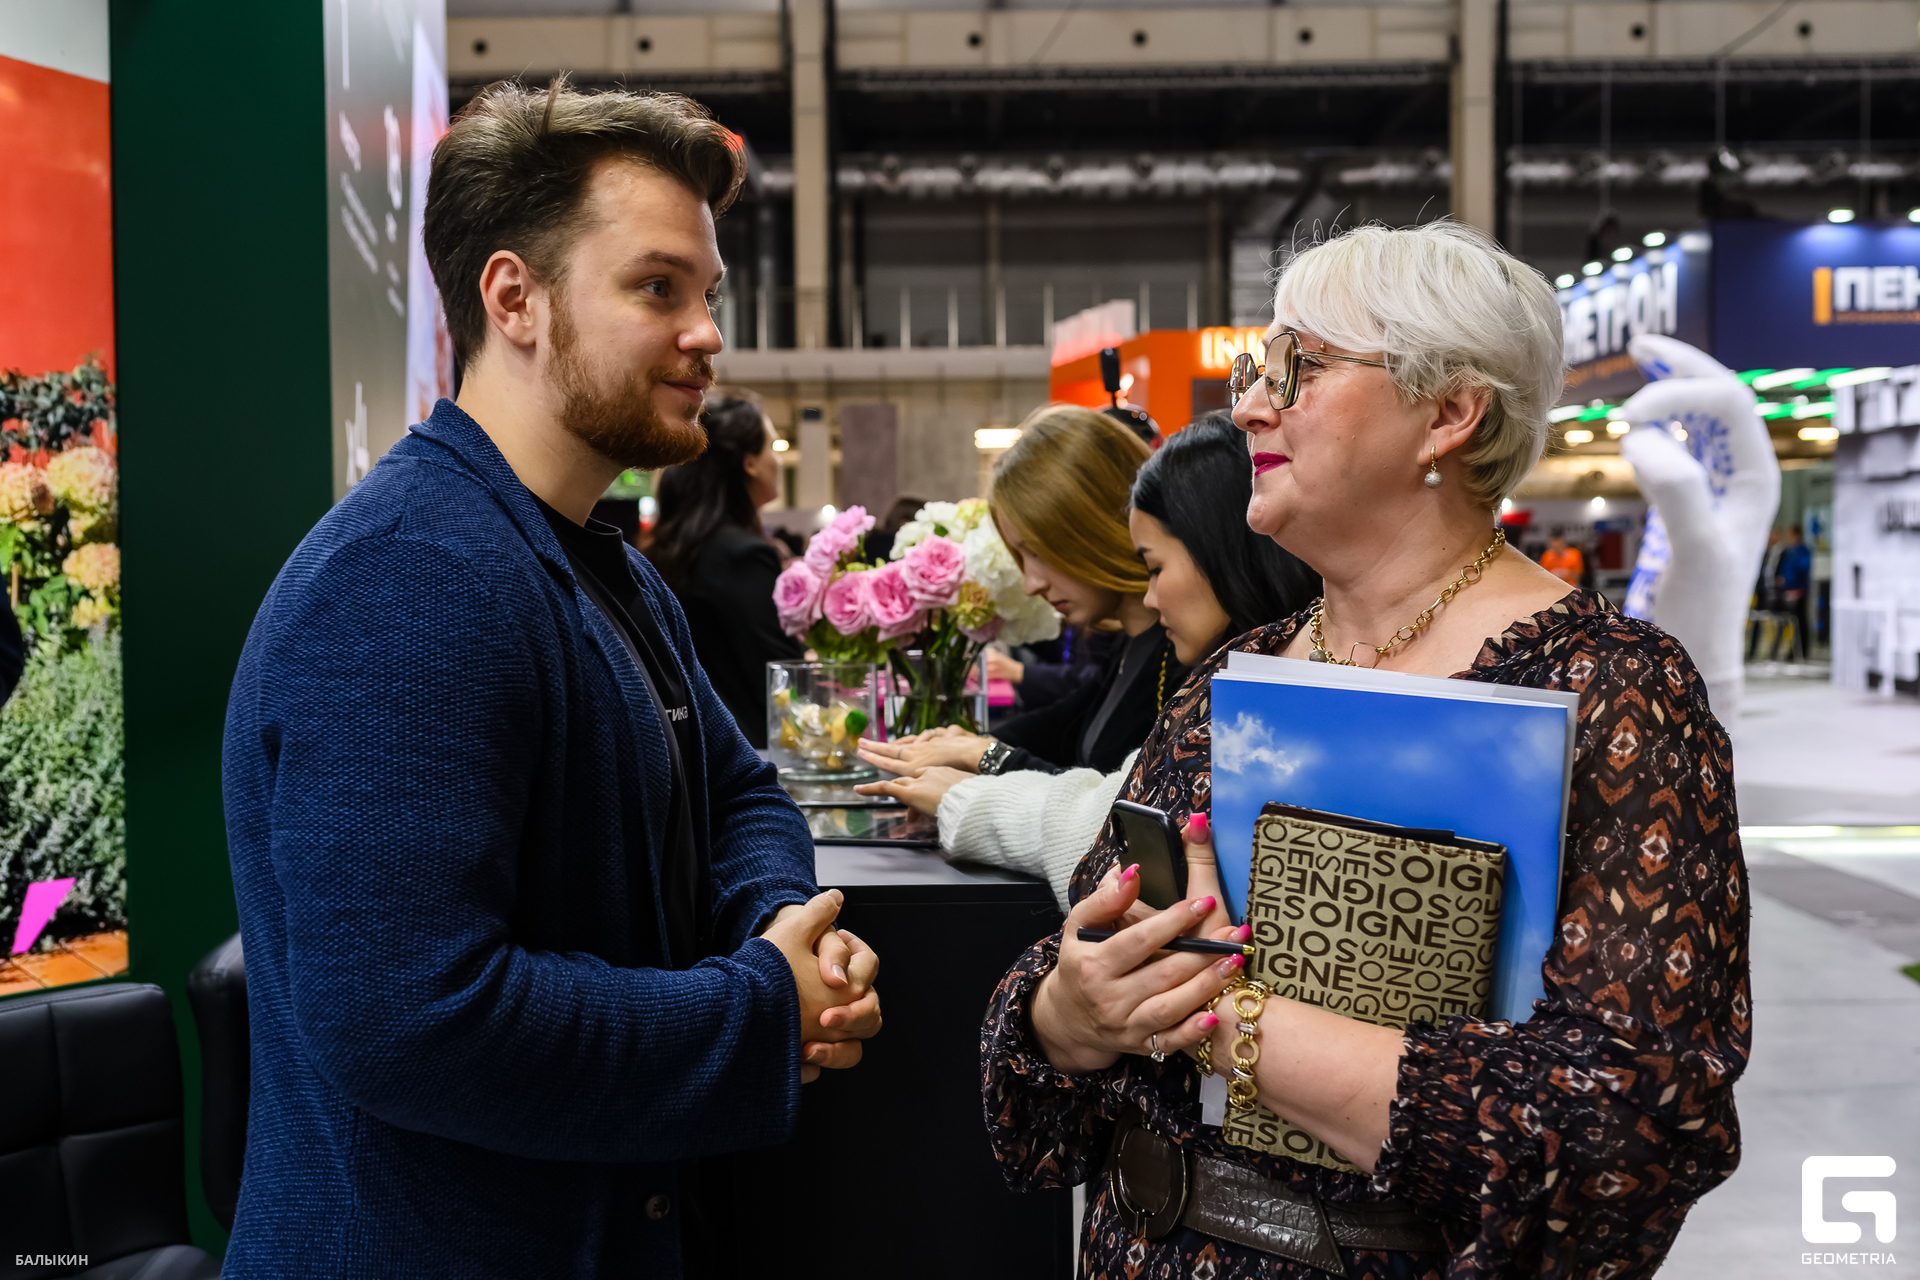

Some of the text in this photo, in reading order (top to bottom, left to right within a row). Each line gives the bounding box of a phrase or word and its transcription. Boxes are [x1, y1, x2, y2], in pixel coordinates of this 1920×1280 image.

[1282, 895, 1453, 949] SOIGNE
[1257, 948, 1356, 993] IGNE
[1352, 940, 1387, 1024] SOIG
